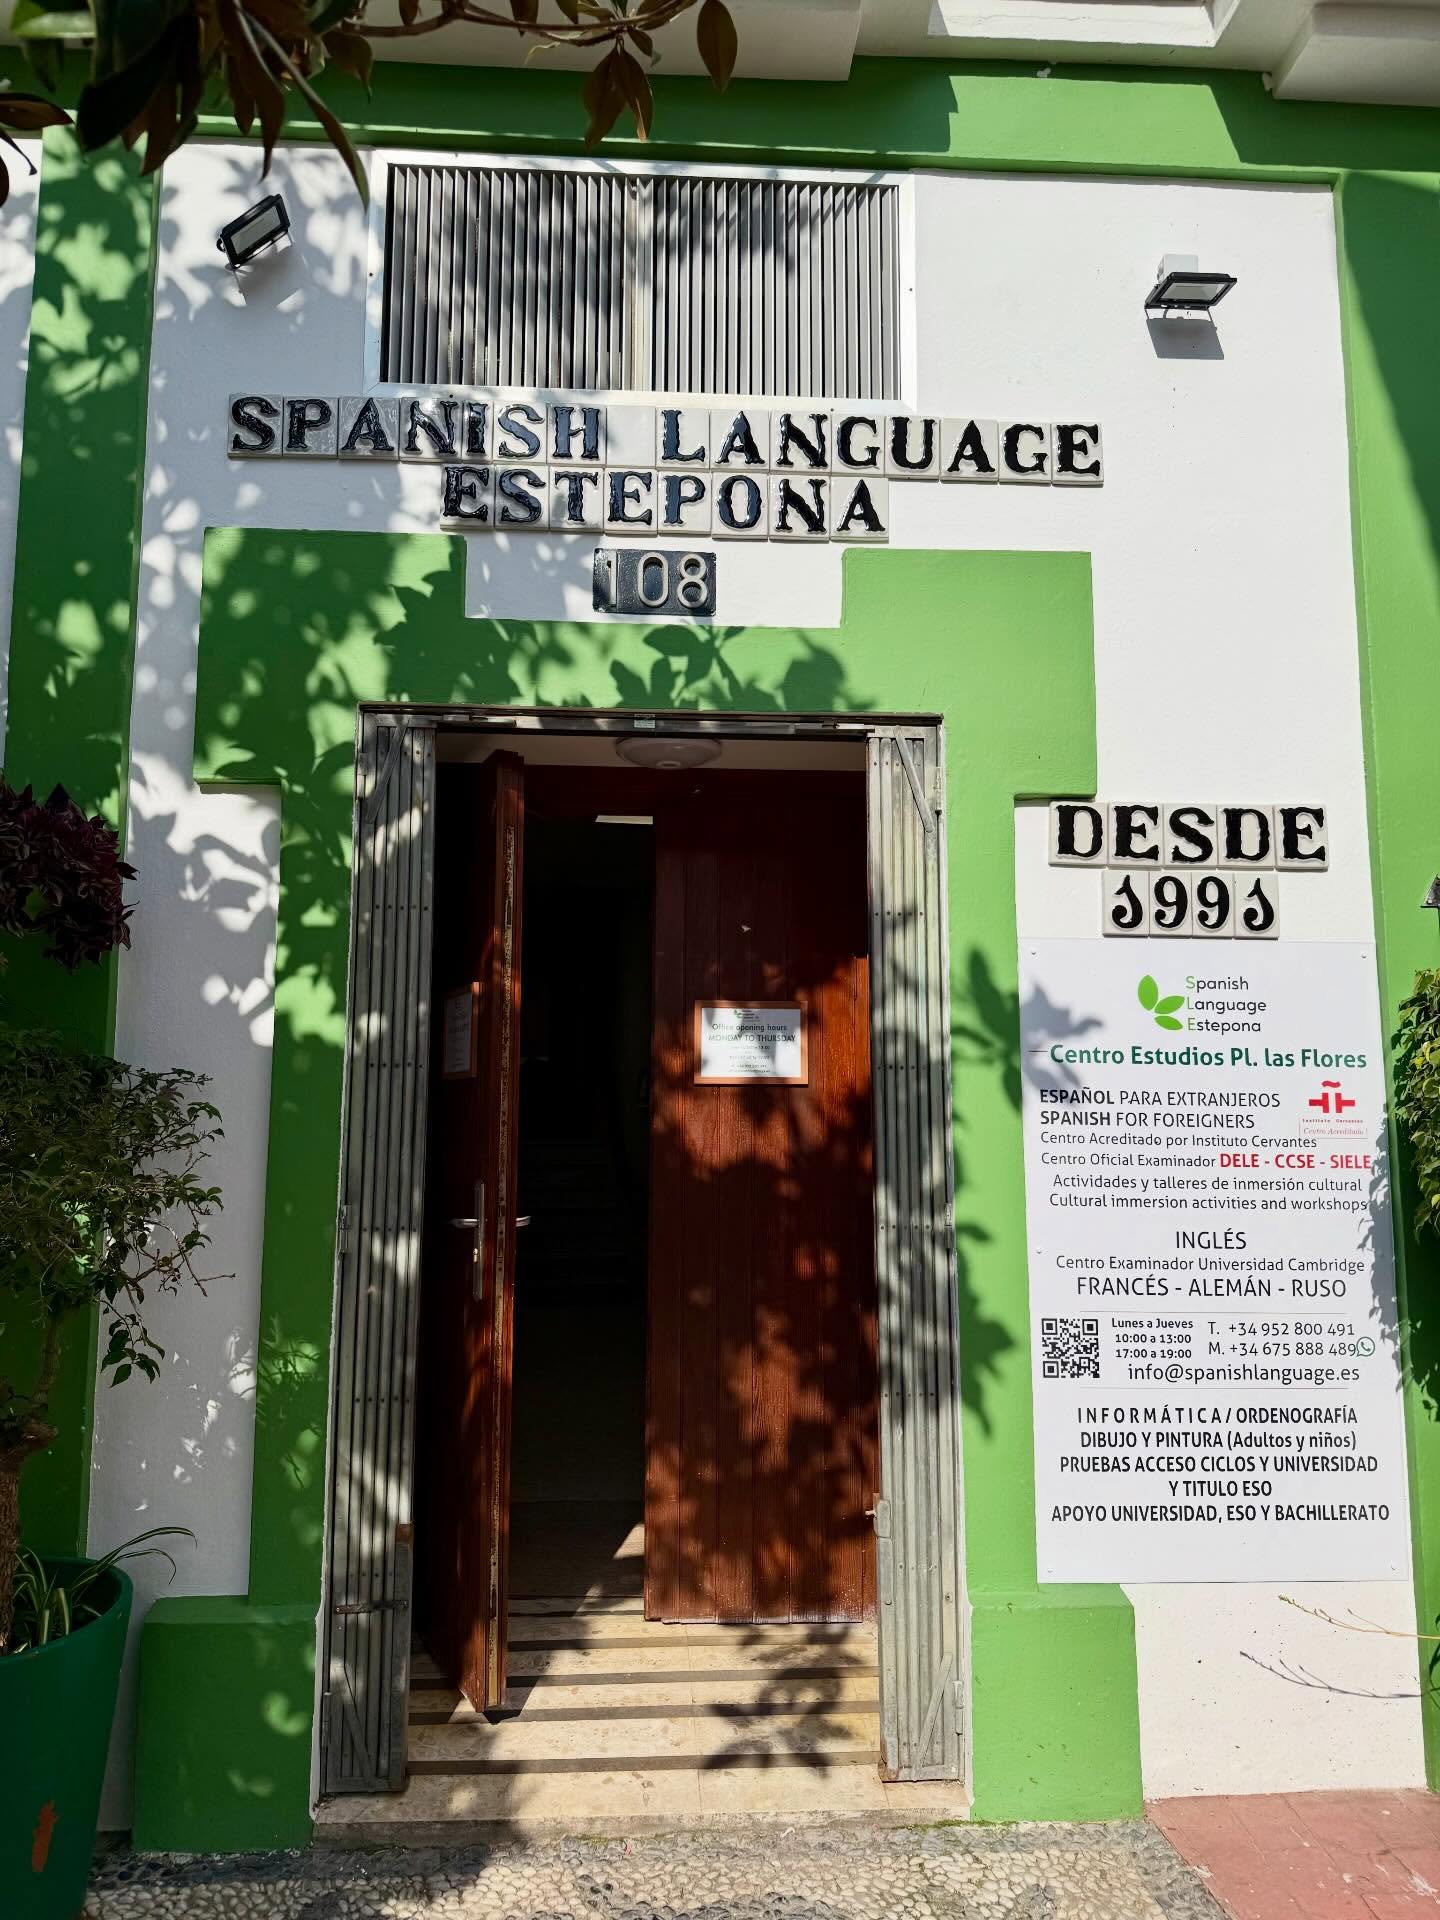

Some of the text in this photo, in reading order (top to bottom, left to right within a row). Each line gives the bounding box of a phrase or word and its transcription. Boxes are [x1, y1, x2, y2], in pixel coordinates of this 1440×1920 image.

[231, 396, 1101, 475] SPANISH LANGUAGE
[442, 466, 886, 533] ESTEPONA
[601, 551, 708, 609] 108
[1056, 804, 1326, 863] DESDE
[1111, 874, 1275, 931] 1991
[1185, 976, 1249, 993] Spanish
[1186, 997, 1267, 1016] Language
[735, 1024, 765, 1032] opening
[1187, 1018, 1261, 1035] Estepona
[708, 1034, 743, 1042] MONDAY
[757, 1034, 796, 1042] THURSDAY
[1050, 1044, 1367, 1069] Centro Estudios Pl. las Flores
[1040, 1087, 1281, 1108] ESPAÑOL PARA EXTRANJEROS
[1040, 1111, 1255, 1129] SPANISH FOR FOREIGNERS
[1040, 1132, 1317, 1149] Centro Acreditado por Instituto Cervantes
[1041, 1153, 1086, 1167] Centro
[1090, 1153, 1134, 1167] Oficial
[1138, 1154, 1216, 1168] Examinador
[1220, 1153, 1260, 1168] DELE
[1275, 1154, 1315, 1169] CCSE
[1330, 1155, 1372, 1169] SIELE
[1053, 1174, 1362, 1192] Actividades y talleres de inmersión cultural
[1050, 1193, 1367, 1213] Cultural immersion activities and workshops
[1175, 1228, 1247, 1250] INGLÉS
[1056, 1255, 1365, 1275] Centro Examinador Universidad Cambridge
[1077, 1274, 1169, 1296] FRANCÉS
[1188, 1274, 1271, 1297] ALEMÁN
[1292, 1279, 1346, 1297] RUSO
[1111, 1318, 1193, 1330] Lunes a Jueves
[1208, 1322, 1355, 1336] T. +34 952 800 491
[1115, 1334, 1192, 1344] 10:00 a 13:00
[1115, 1349, 1192, 1359] 17:00 a 19:00
[1208, 1342, 1356, 1357] M. +34 675 888 489
[1127, 1364, 1360, 1385] info@spanishlanguage.es
[1080, 1431, 1356, 1452] DIBUJO Y PINTURA (Adultos y niños)
[1060, 1456, 1378, 1473] PRUEBAS ACCESO CICLOS Y UNIVERSIDAD
[1168, 1480, 1272, 1497] Y TITULO ESO
[1052, 1505, 1390, 1523] APOYO UNIVERSIDAD, ESO Y BACHILLERATO
